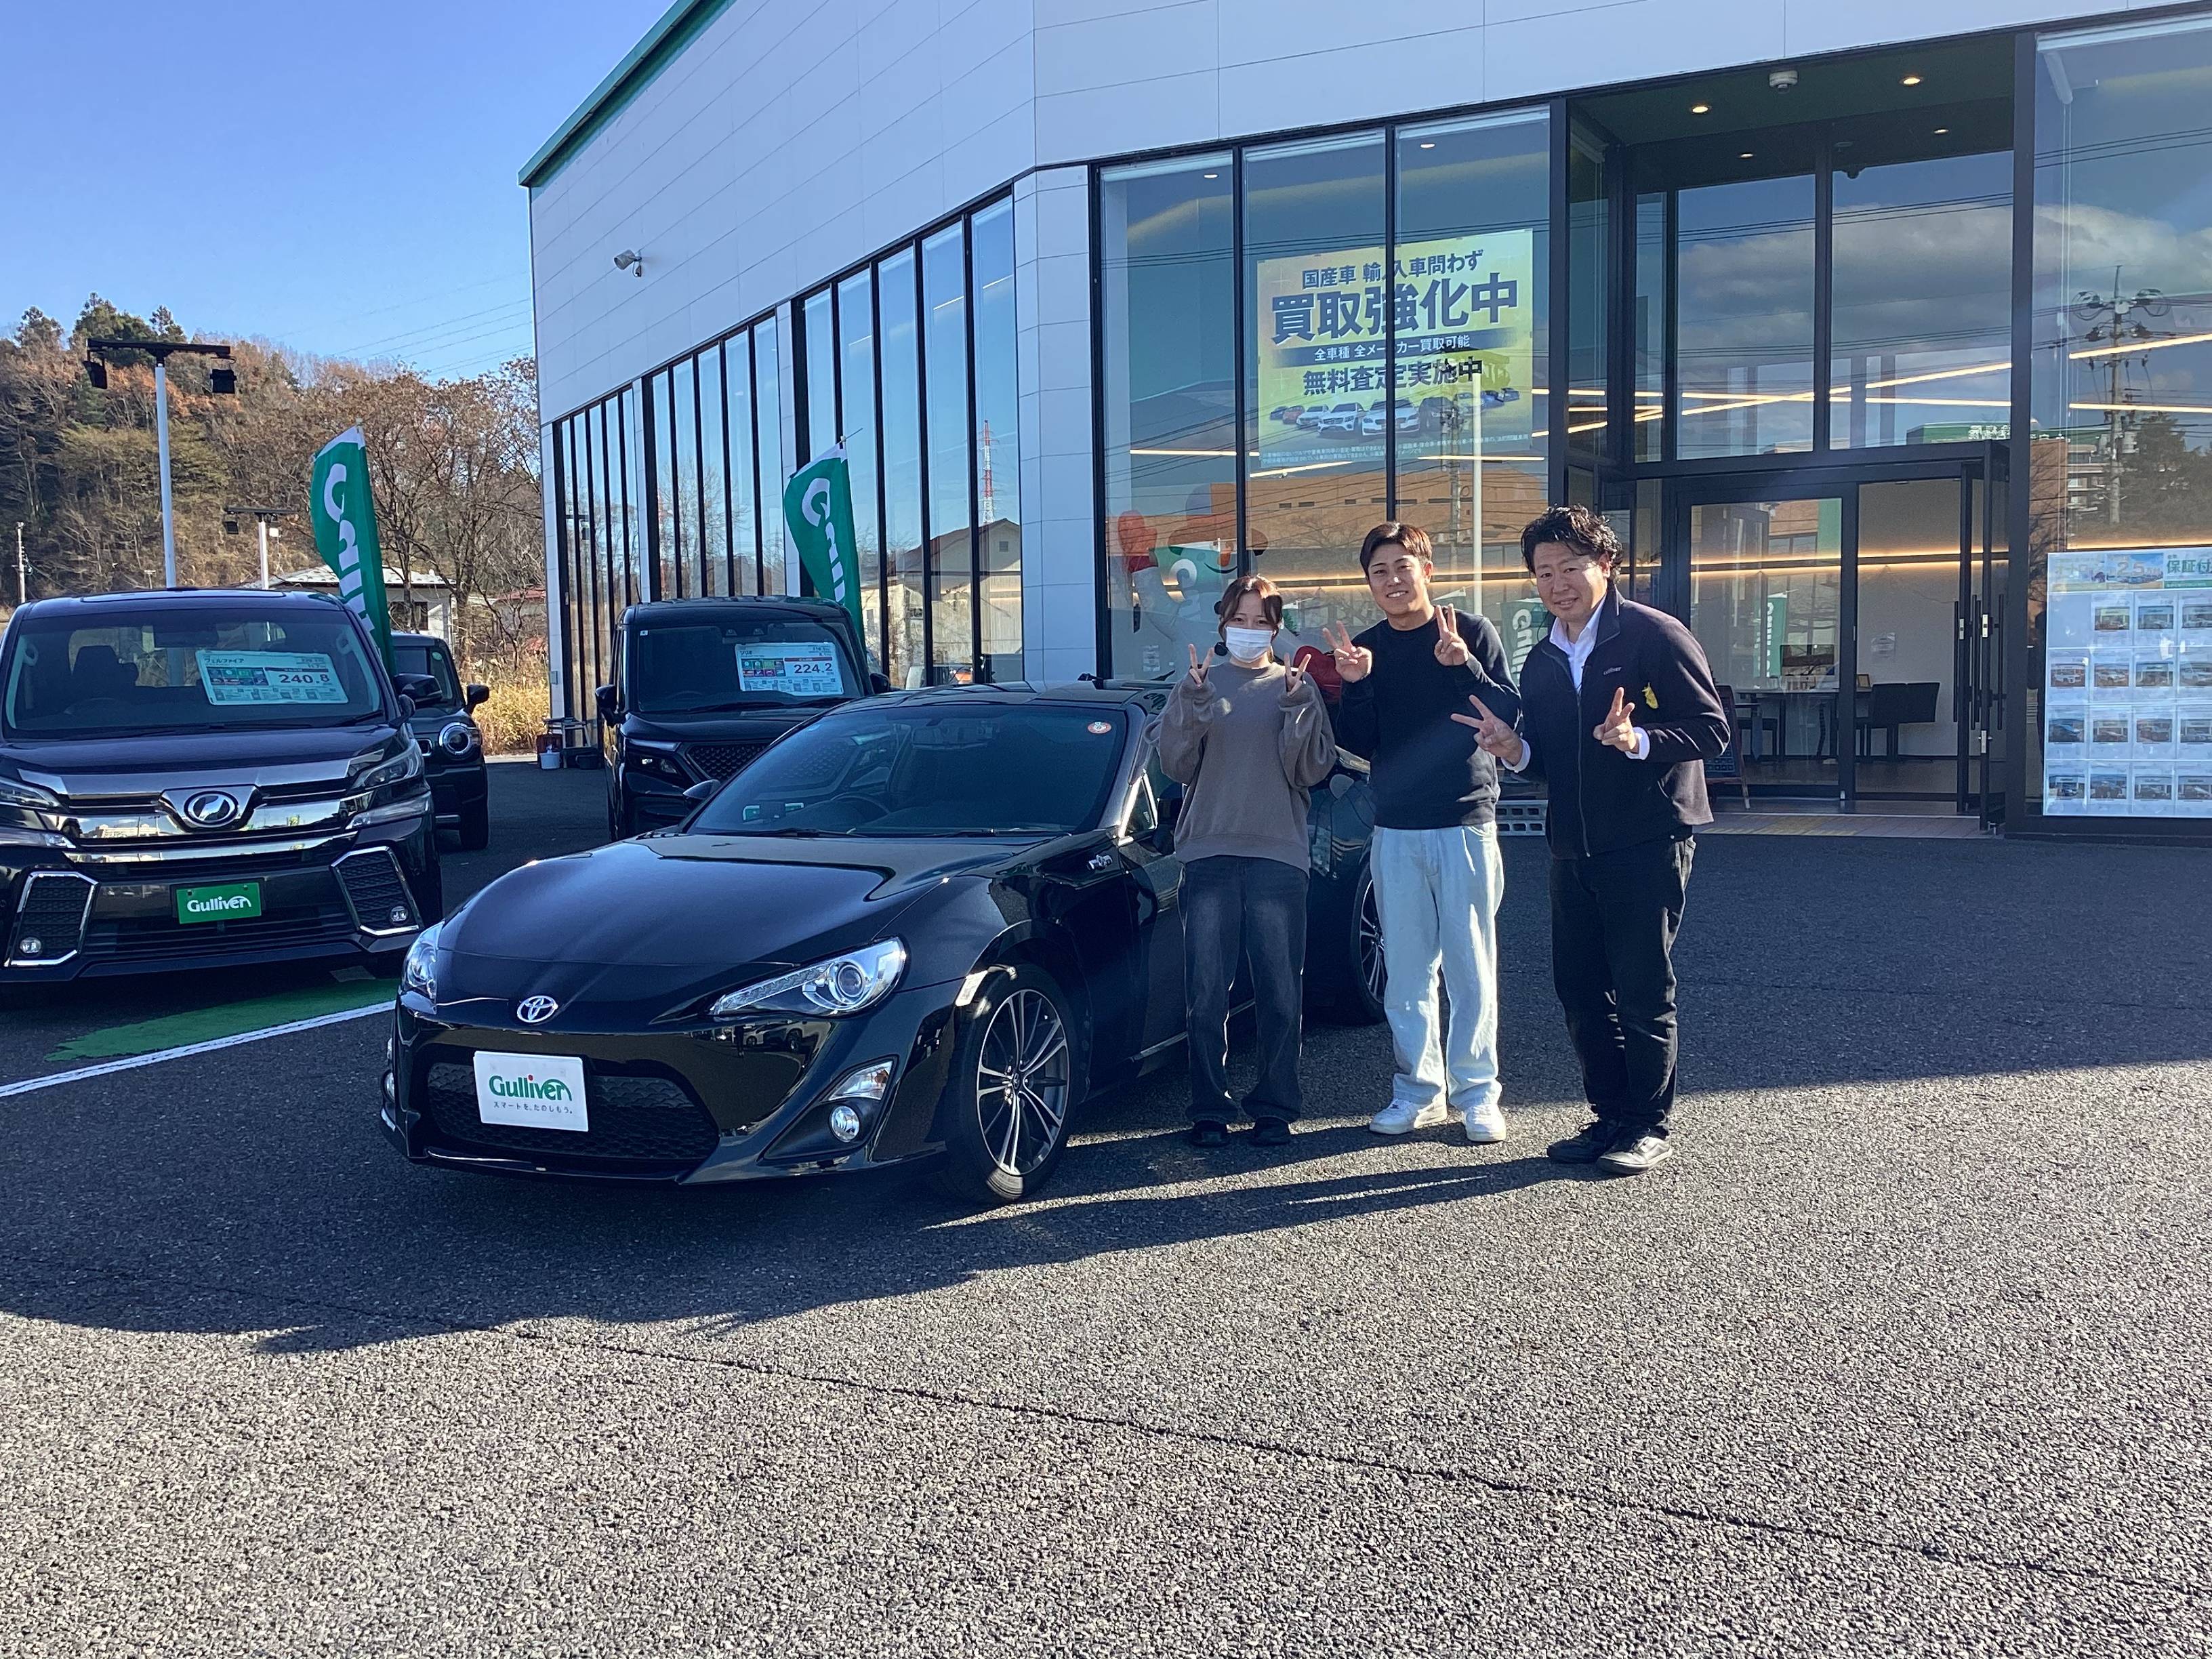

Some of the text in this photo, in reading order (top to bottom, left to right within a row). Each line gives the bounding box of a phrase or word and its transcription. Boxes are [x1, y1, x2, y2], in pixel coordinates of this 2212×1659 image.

[1302, 249, 1484, 289] 国産車 輸入車問わず
[1271, 272, 1517, 345] 買取強化中
[1314, 344, 1350, 361] 全車種
[1303, 356, 1483, 396] 無料査定実施中
[794, 663, 833, 674] 224.2
[279, 674, 330, 684] 240.8
[187, 895, 251, 912] Gulliver
[489, 1074, 573, 1101] Gulliver
[493, 1101, 573, 1114] スマートを、たのしもう。
